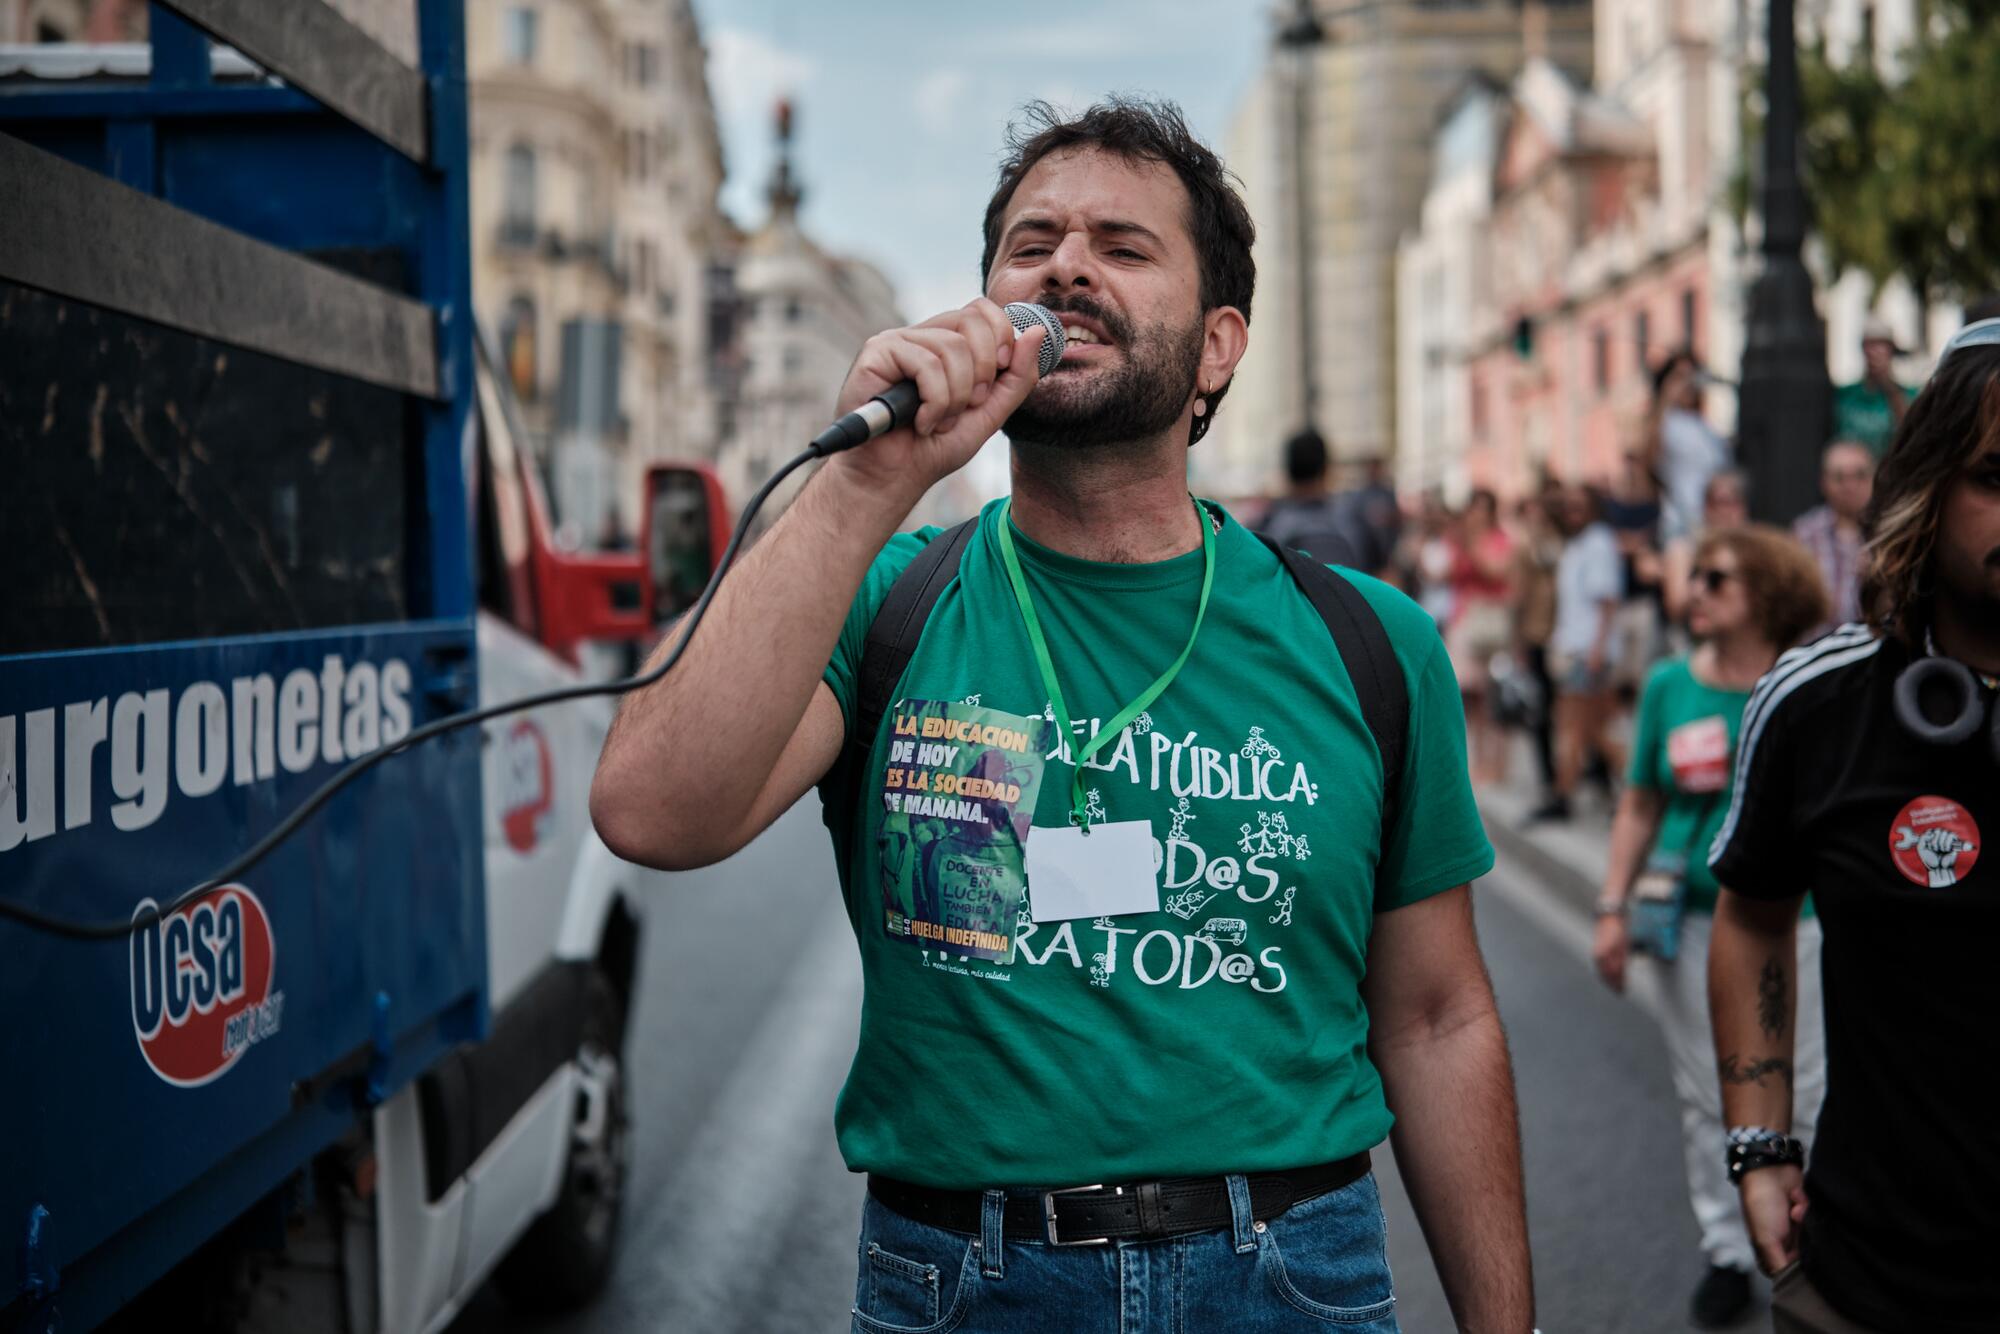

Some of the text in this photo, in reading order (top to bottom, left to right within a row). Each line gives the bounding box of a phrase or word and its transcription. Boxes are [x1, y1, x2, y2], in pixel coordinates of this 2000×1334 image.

[895, 715, 1028, 753] LA EDUCACIÓN
[890, 741, 959, 768] DE HOY
[1150, 731, 1318, 805] PÚBLICA:
[886, 768, 1021, 803] ES LA SOCIEDAD
[884, 792, 989, 824] DE MAÑANA.
[946, 859, 1003, 877] DOCENTE
[969, 876, 990, 889] EN
[943, 883, 1003, 904] LUCHA
[911, 920, 944, 941] HUELGA
[946, 927, 1008, 952] INDEFINIDA
[946, 913, 999, 932] EDUCA
[1093, 925, 1287, 993] TOD@S
